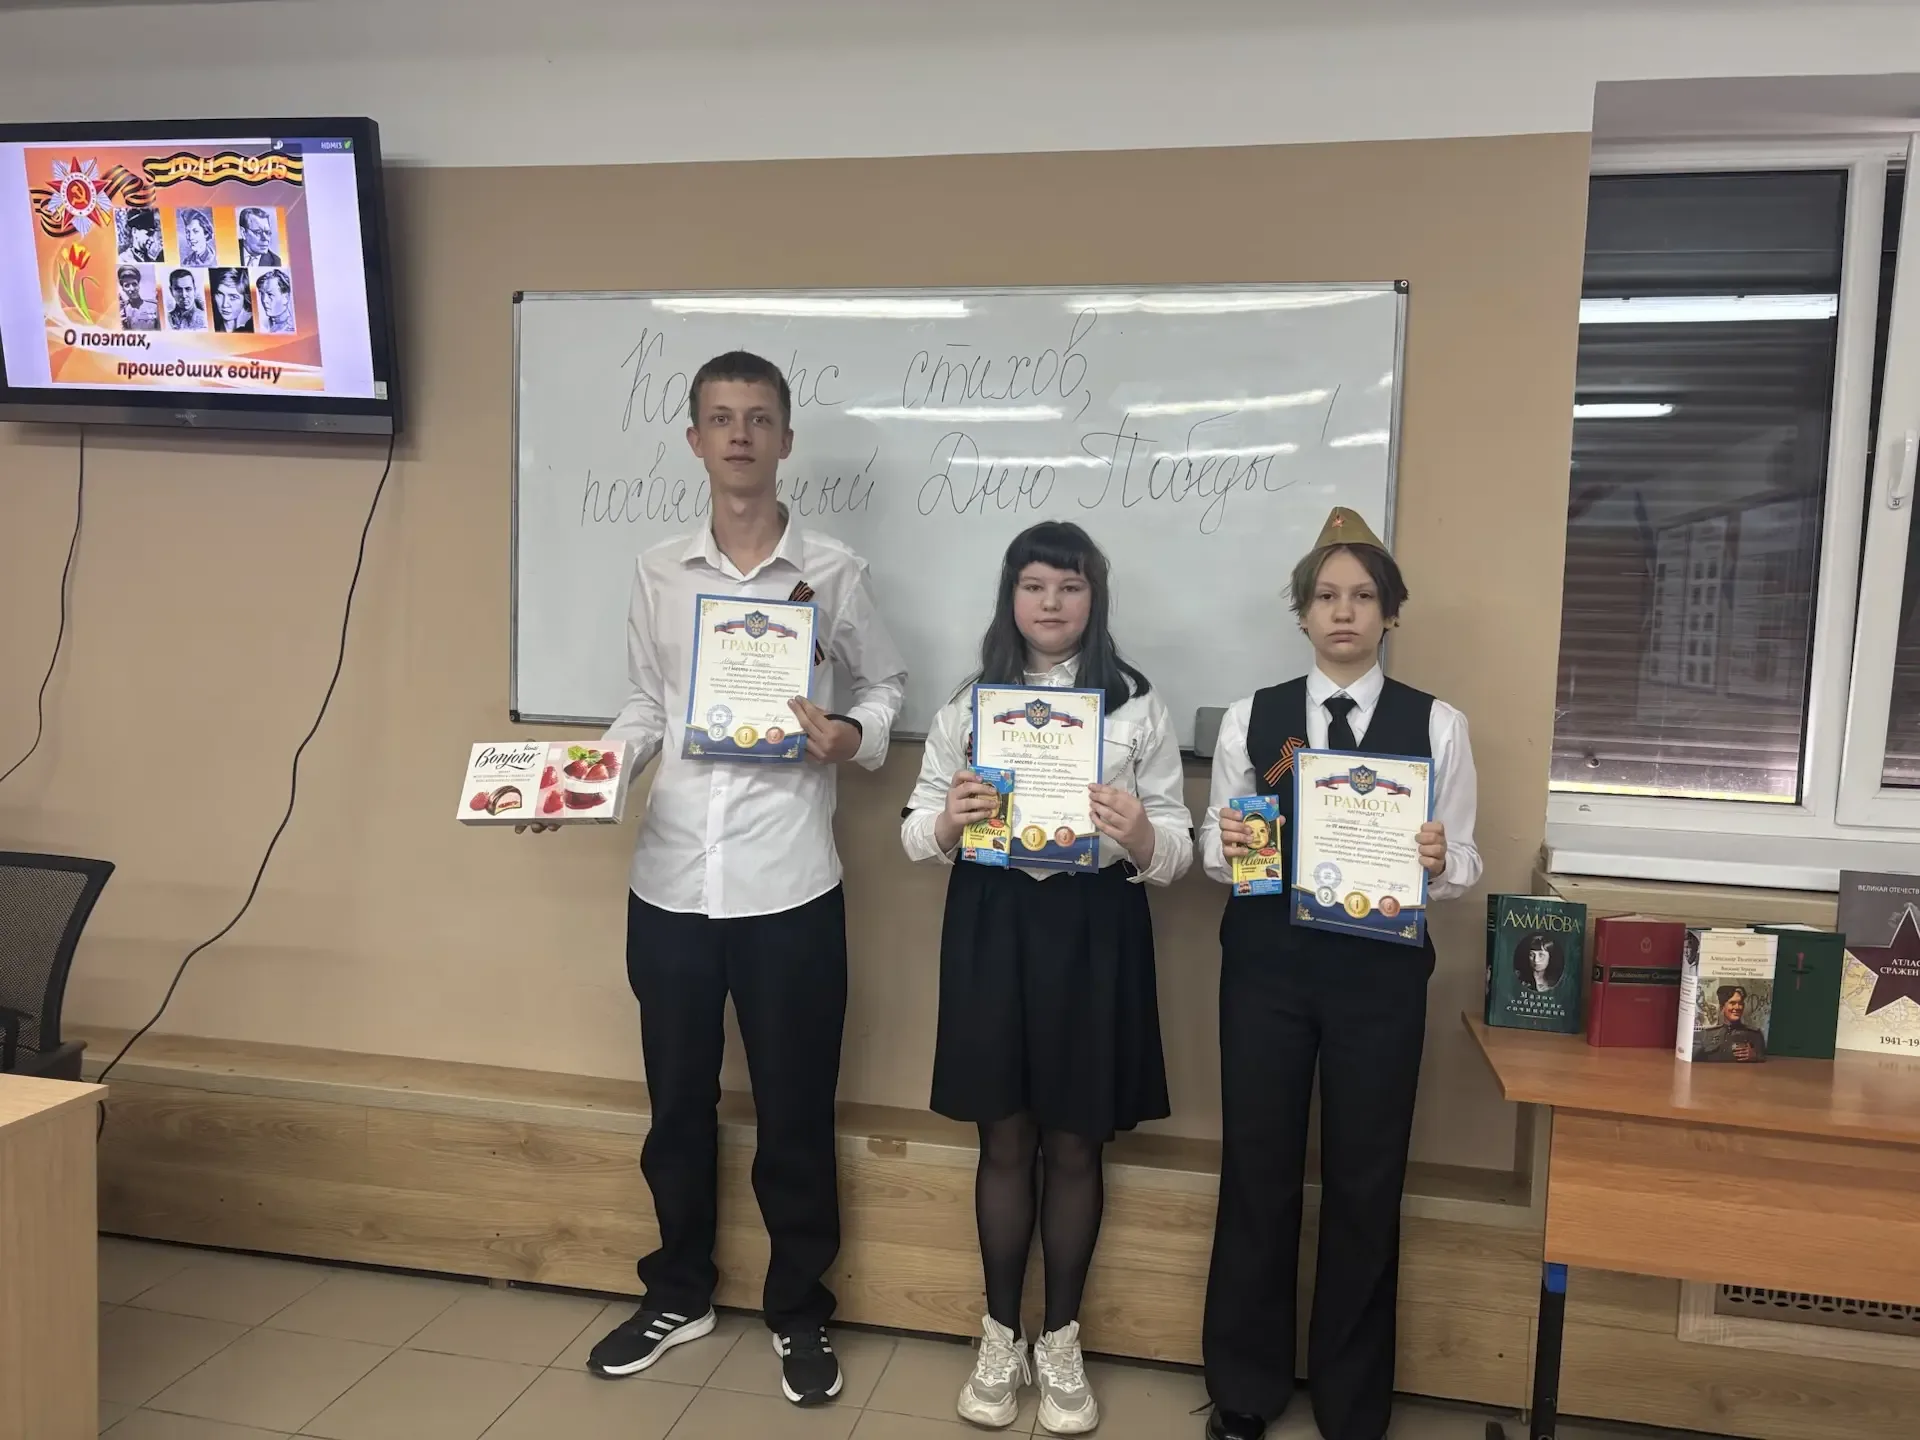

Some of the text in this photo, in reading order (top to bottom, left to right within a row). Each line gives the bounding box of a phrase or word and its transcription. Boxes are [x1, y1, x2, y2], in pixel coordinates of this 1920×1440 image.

[168, 156, 215, 180] 1941
[236, 155, 289, 180] 1945
[63, 328, 151, 350] О поэтах,
[117, 359, 283, 384] прошедших войну
[902, 307, 1092, 423] стихов,
[917, 431, 1057, 516] Дню
[721, 639, 788, 654] ГРАМОТА
[1001, 730, 1074, 746] ГРАМОТА
[474, 747, 541, 770] Bonjour
[1324, 794, 1401, 813] ГРАМОТА
[1858, 884, 1888, 892] ВЕЛИКАЯ
[1503, 909, 1580, 934] АХМАТОВА
